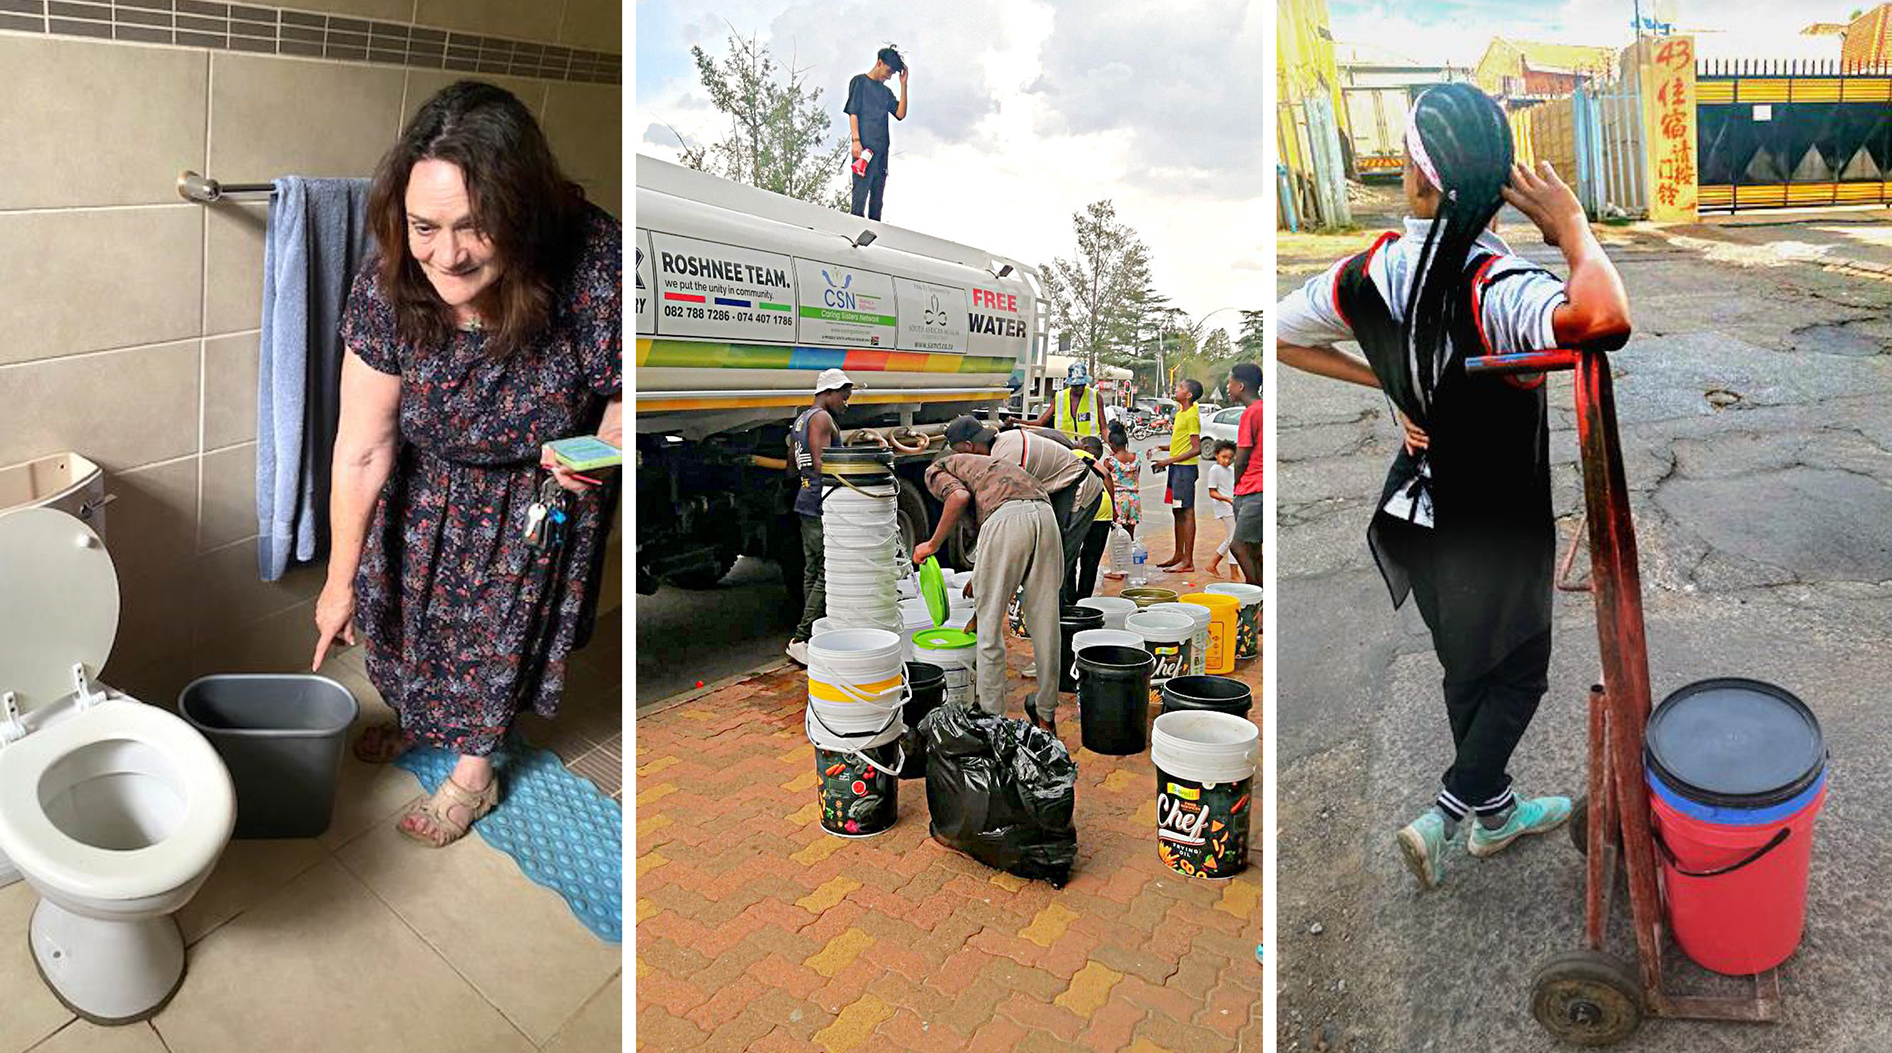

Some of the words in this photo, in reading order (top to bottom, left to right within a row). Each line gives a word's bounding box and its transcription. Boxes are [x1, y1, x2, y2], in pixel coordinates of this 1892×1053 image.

[1656, 40, 1690, 72] 43
[1657, 77, 1687, 139] 住宿
[661, 252, 743, 282] ROSHNEE
[745, 264, 790, 288] TEAM.
[665, 280, 678, 288] we
[680, 281, 693, 291] put
[694, 282, 707, 291] the
[708, 284, 727, 296] unity
[728, 285, 735, 294] in
[824, 289, 856, 310] CSN
[973, 288, 1017, 313] FREE
[664, 305, 683, 317] 082
[686, 307, 704, 319] 788
[707, 309, 730, 321] 7286
[737, 312, 753, 322] 074
[756, 313, 771, 324] 407
[773, 315, 793, 326] 1786
[821, 309, 840, 320] Caring
[969, 313, 1027, 338] WATER
[1151, 655, 1183, 679] hef
[1157, 793, 1210, 843] Chef
